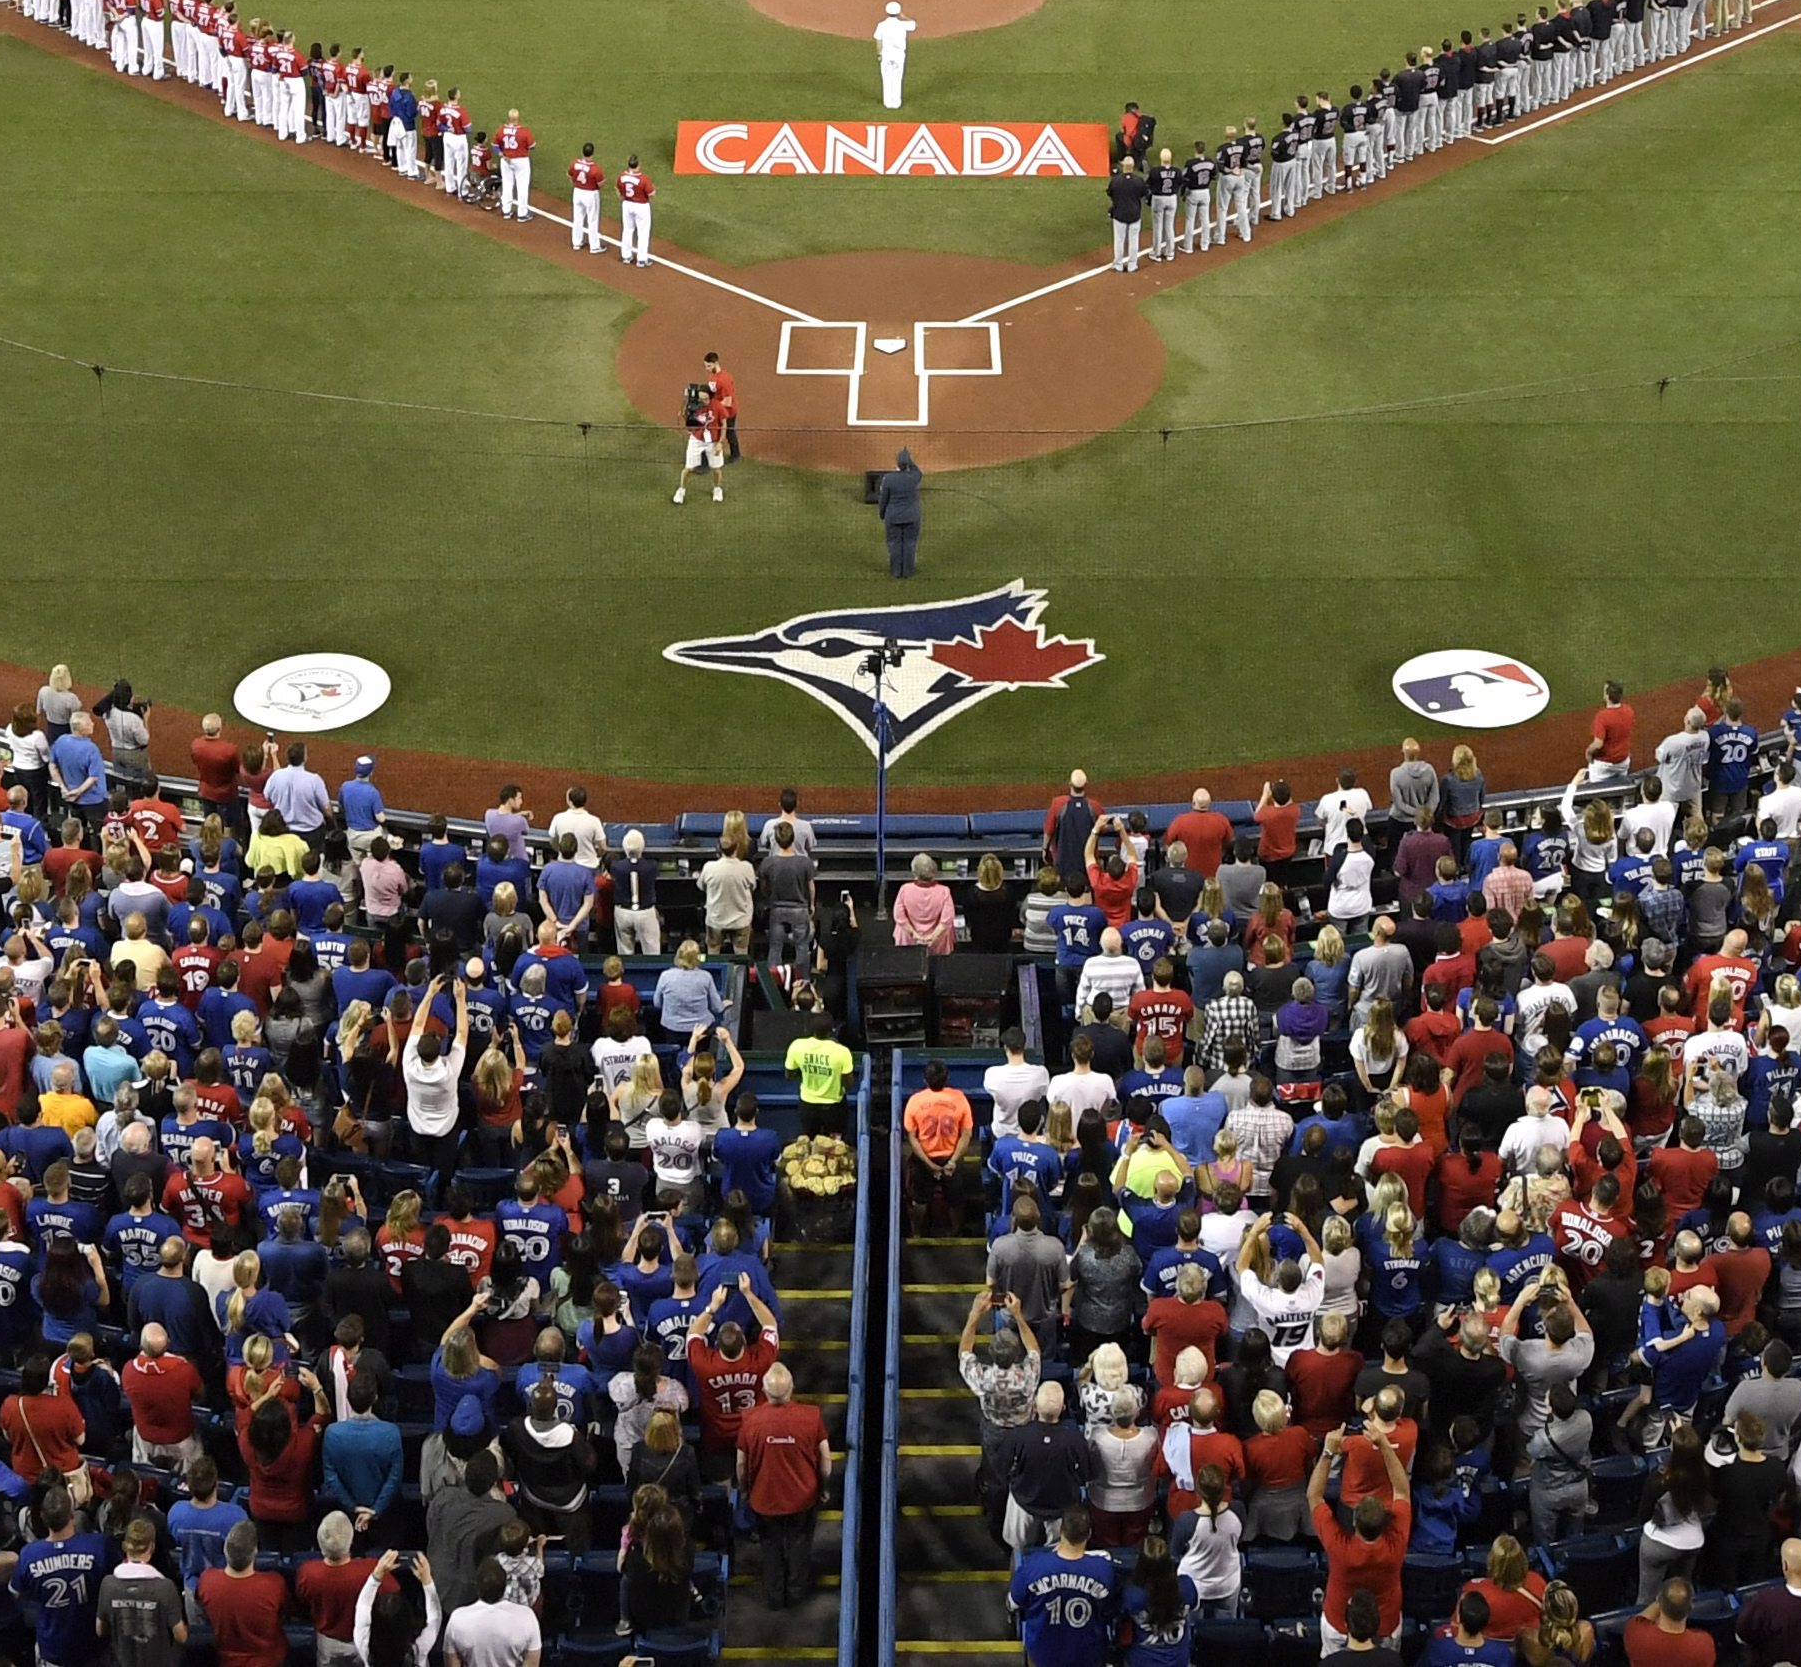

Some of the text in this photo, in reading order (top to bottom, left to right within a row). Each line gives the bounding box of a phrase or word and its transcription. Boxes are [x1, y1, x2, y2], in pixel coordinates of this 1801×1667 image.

[694, 123, 1087, 177] CANADA
[1754, 846, 1778, 858] STAFF
[1062, 914, 1088, 927] PRICE
[179, 955, 210, 968] CANADA
[182, 970, 210, 992] 19
[1140, 1003, 1182, 1017] CANADA
[803, 1052, 830, 1066] SNACK
[803, 1064, 833, 1077] VENDOR
[118, 1227, 158, 1244] MARTIN
[1561, 1229, 1604, 1266] 20
[1383, 1259, 1421, 1271] STROMAN
[1390, 1271, 1409, 1290] 6
[708, 1372, 759, 1388] CANADA
[715, 1389, 757, 1413] 13
[766, 1435, 796, 1445] Canada
[28, 1553, 95, 1578] SAUNDERS
[41, 1573, 89, 1608] 21
[1028, 1573, 1110, 1600] ENCARNACION
[1045, 1595, 1092, 1629] 10
